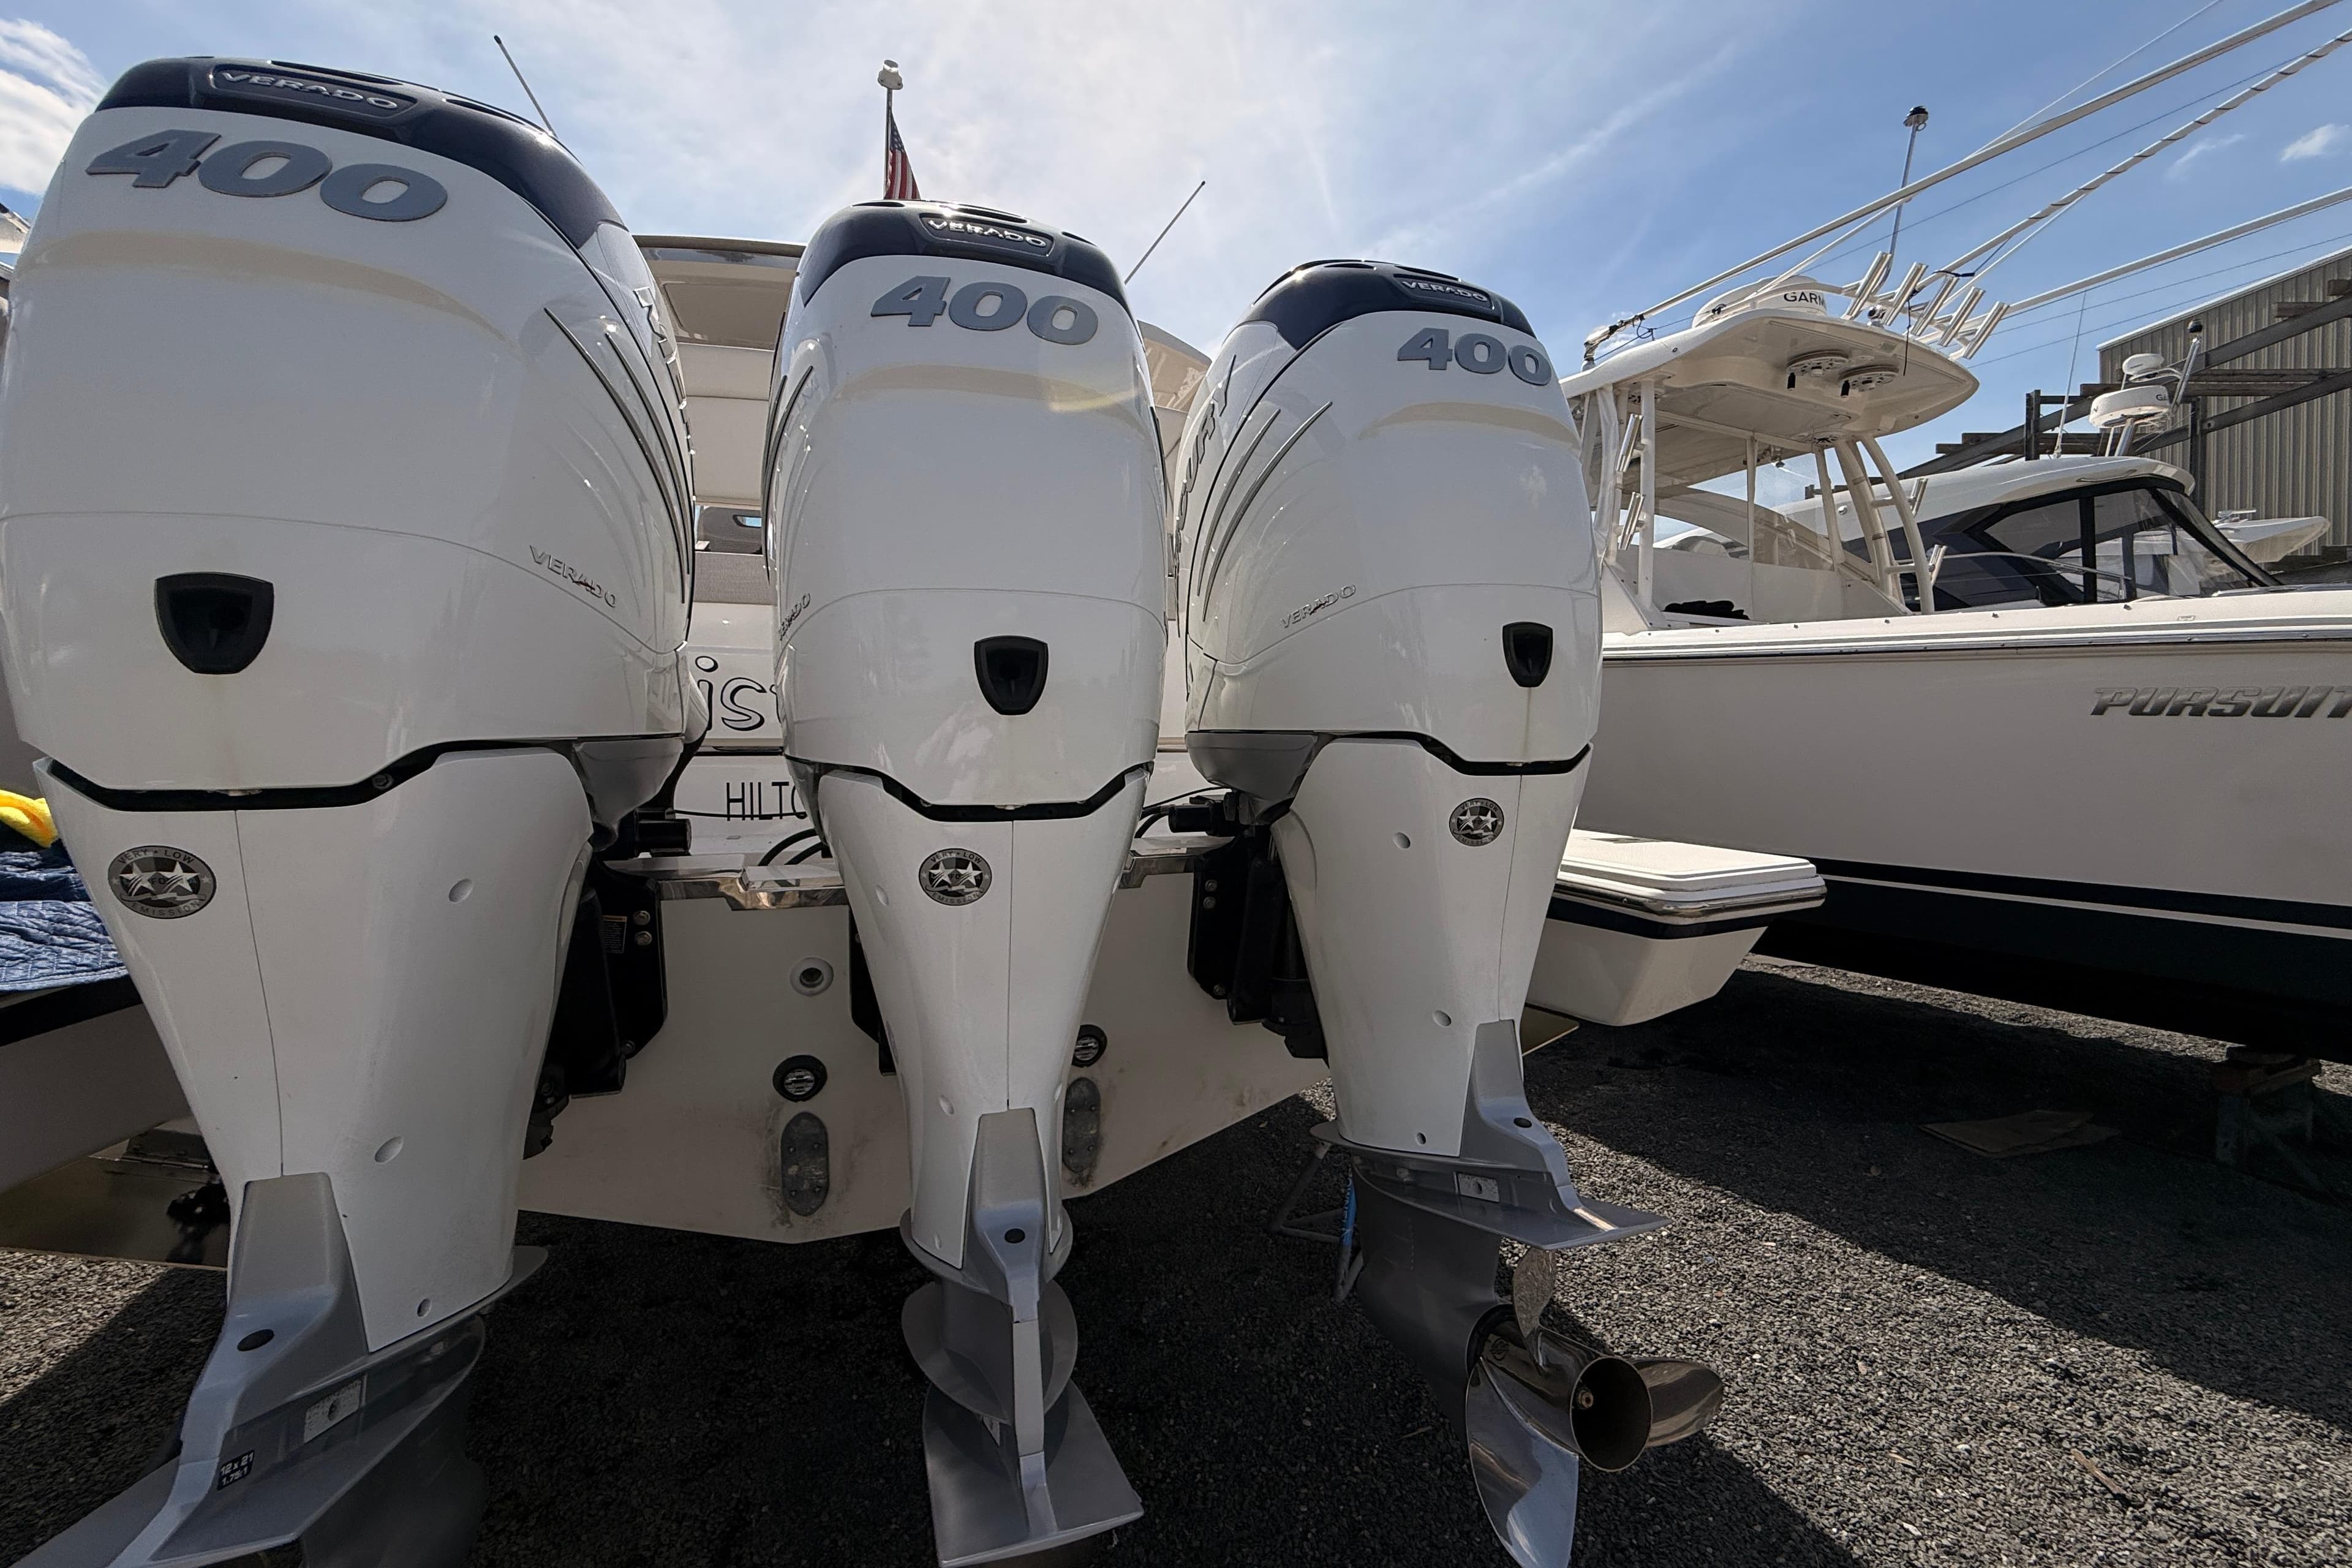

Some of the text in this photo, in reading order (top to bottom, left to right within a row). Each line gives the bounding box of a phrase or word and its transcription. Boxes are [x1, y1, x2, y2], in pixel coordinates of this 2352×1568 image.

[221, 70, 399, 110] VERADO
[86, 129, 448, 222] 400
[927, 219, 1047, 248] VERADO
[870, 275, 1099, 345] 400
[1402, 280, 1490, 303] VERADO
[1397, 326, 1553, 386] 400
[529, 544, 616, 608] VERADO
[1279, 584, 1357, 629] VERADO
[695, 655, 782, 731] is
[1485, 801, 1499, 812] LOW
[118, 848, 195, 864] VERY LOW
[930, 851, 983, 864] VERY LOW
[221, 1462, 233, 1476] 12
[240, 1452, 254, 1466] 21
